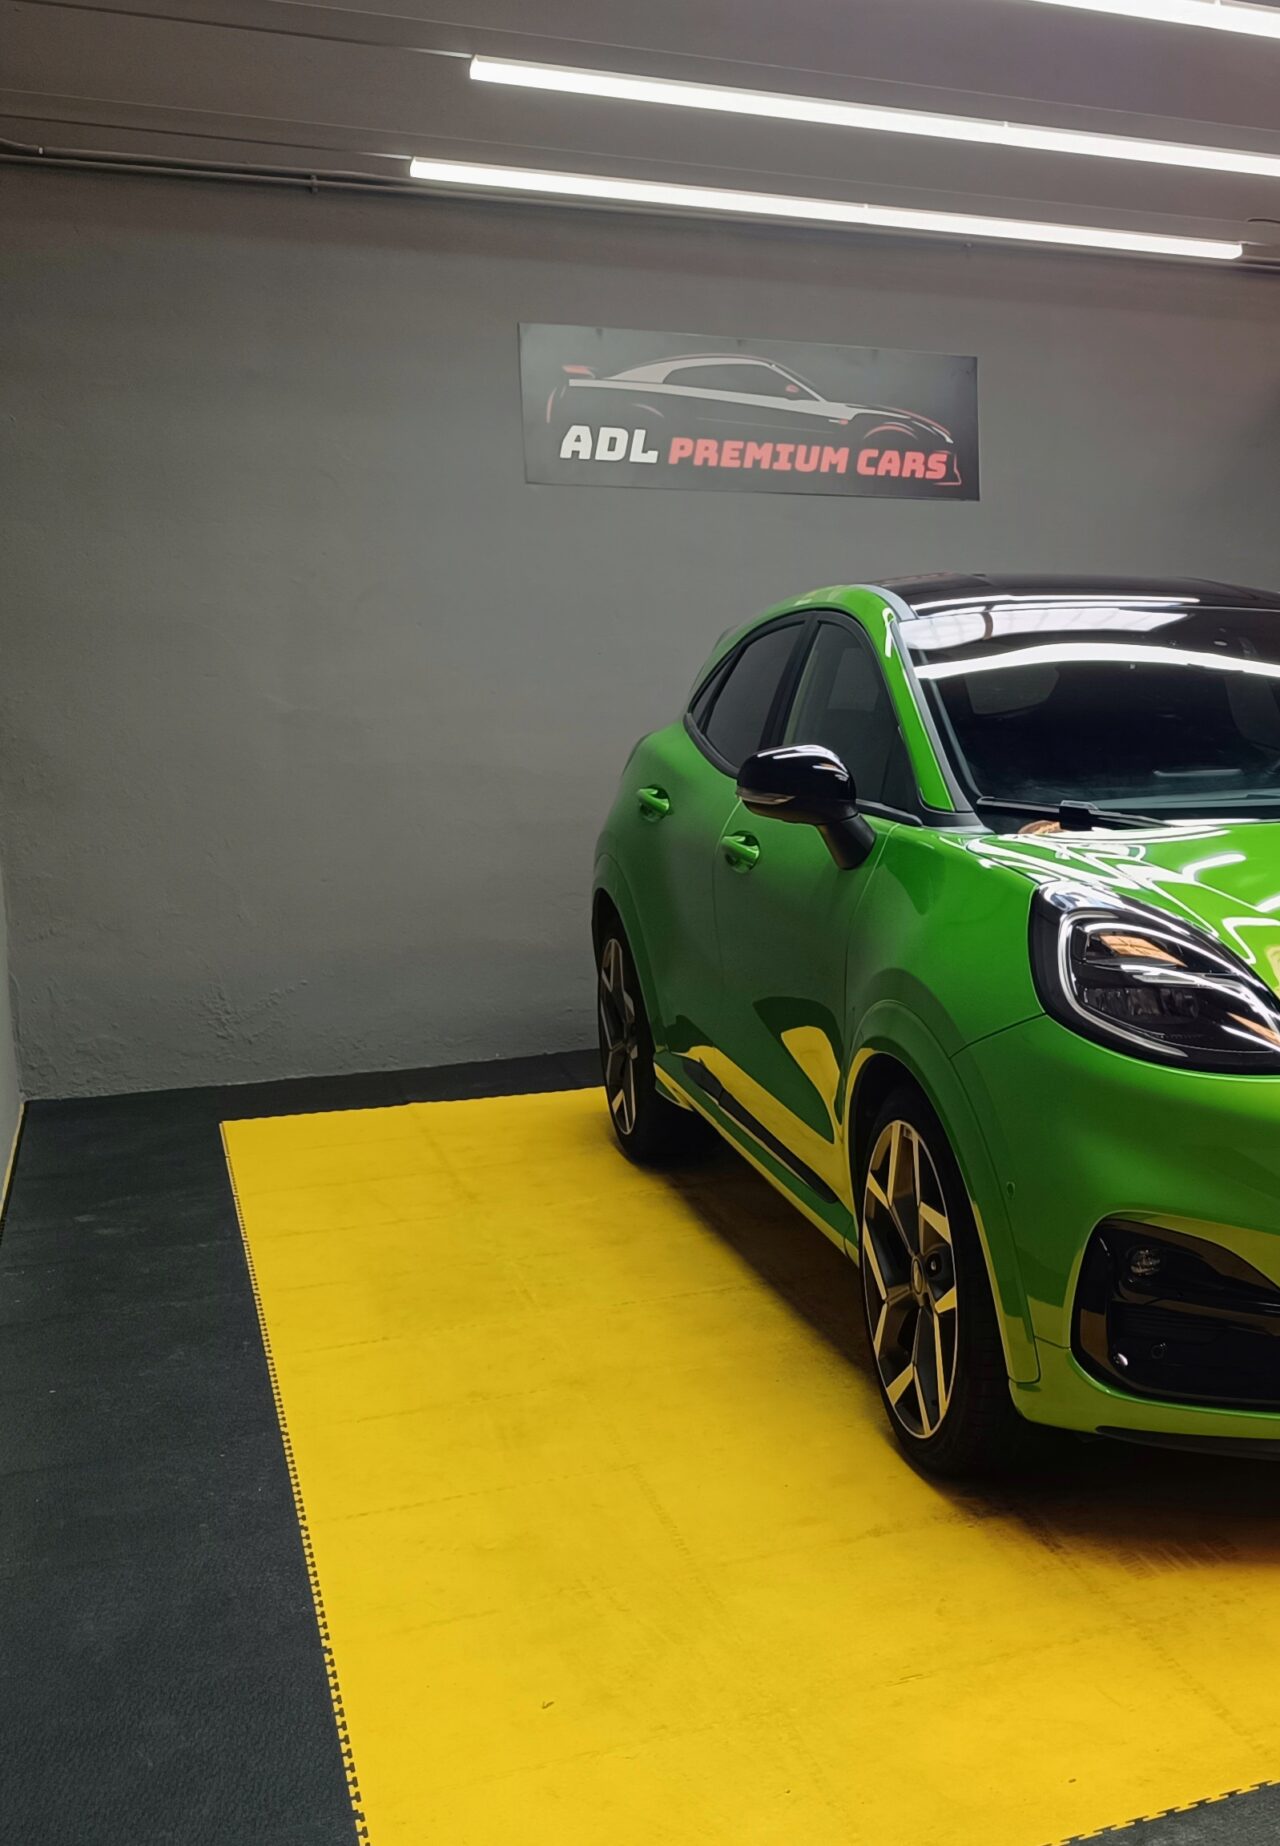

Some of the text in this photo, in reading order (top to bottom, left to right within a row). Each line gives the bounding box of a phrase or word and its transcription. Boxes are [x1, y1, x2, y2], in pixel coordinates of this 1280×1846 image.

[559, 424, 948, 480] ADL PREMIUM CARS
